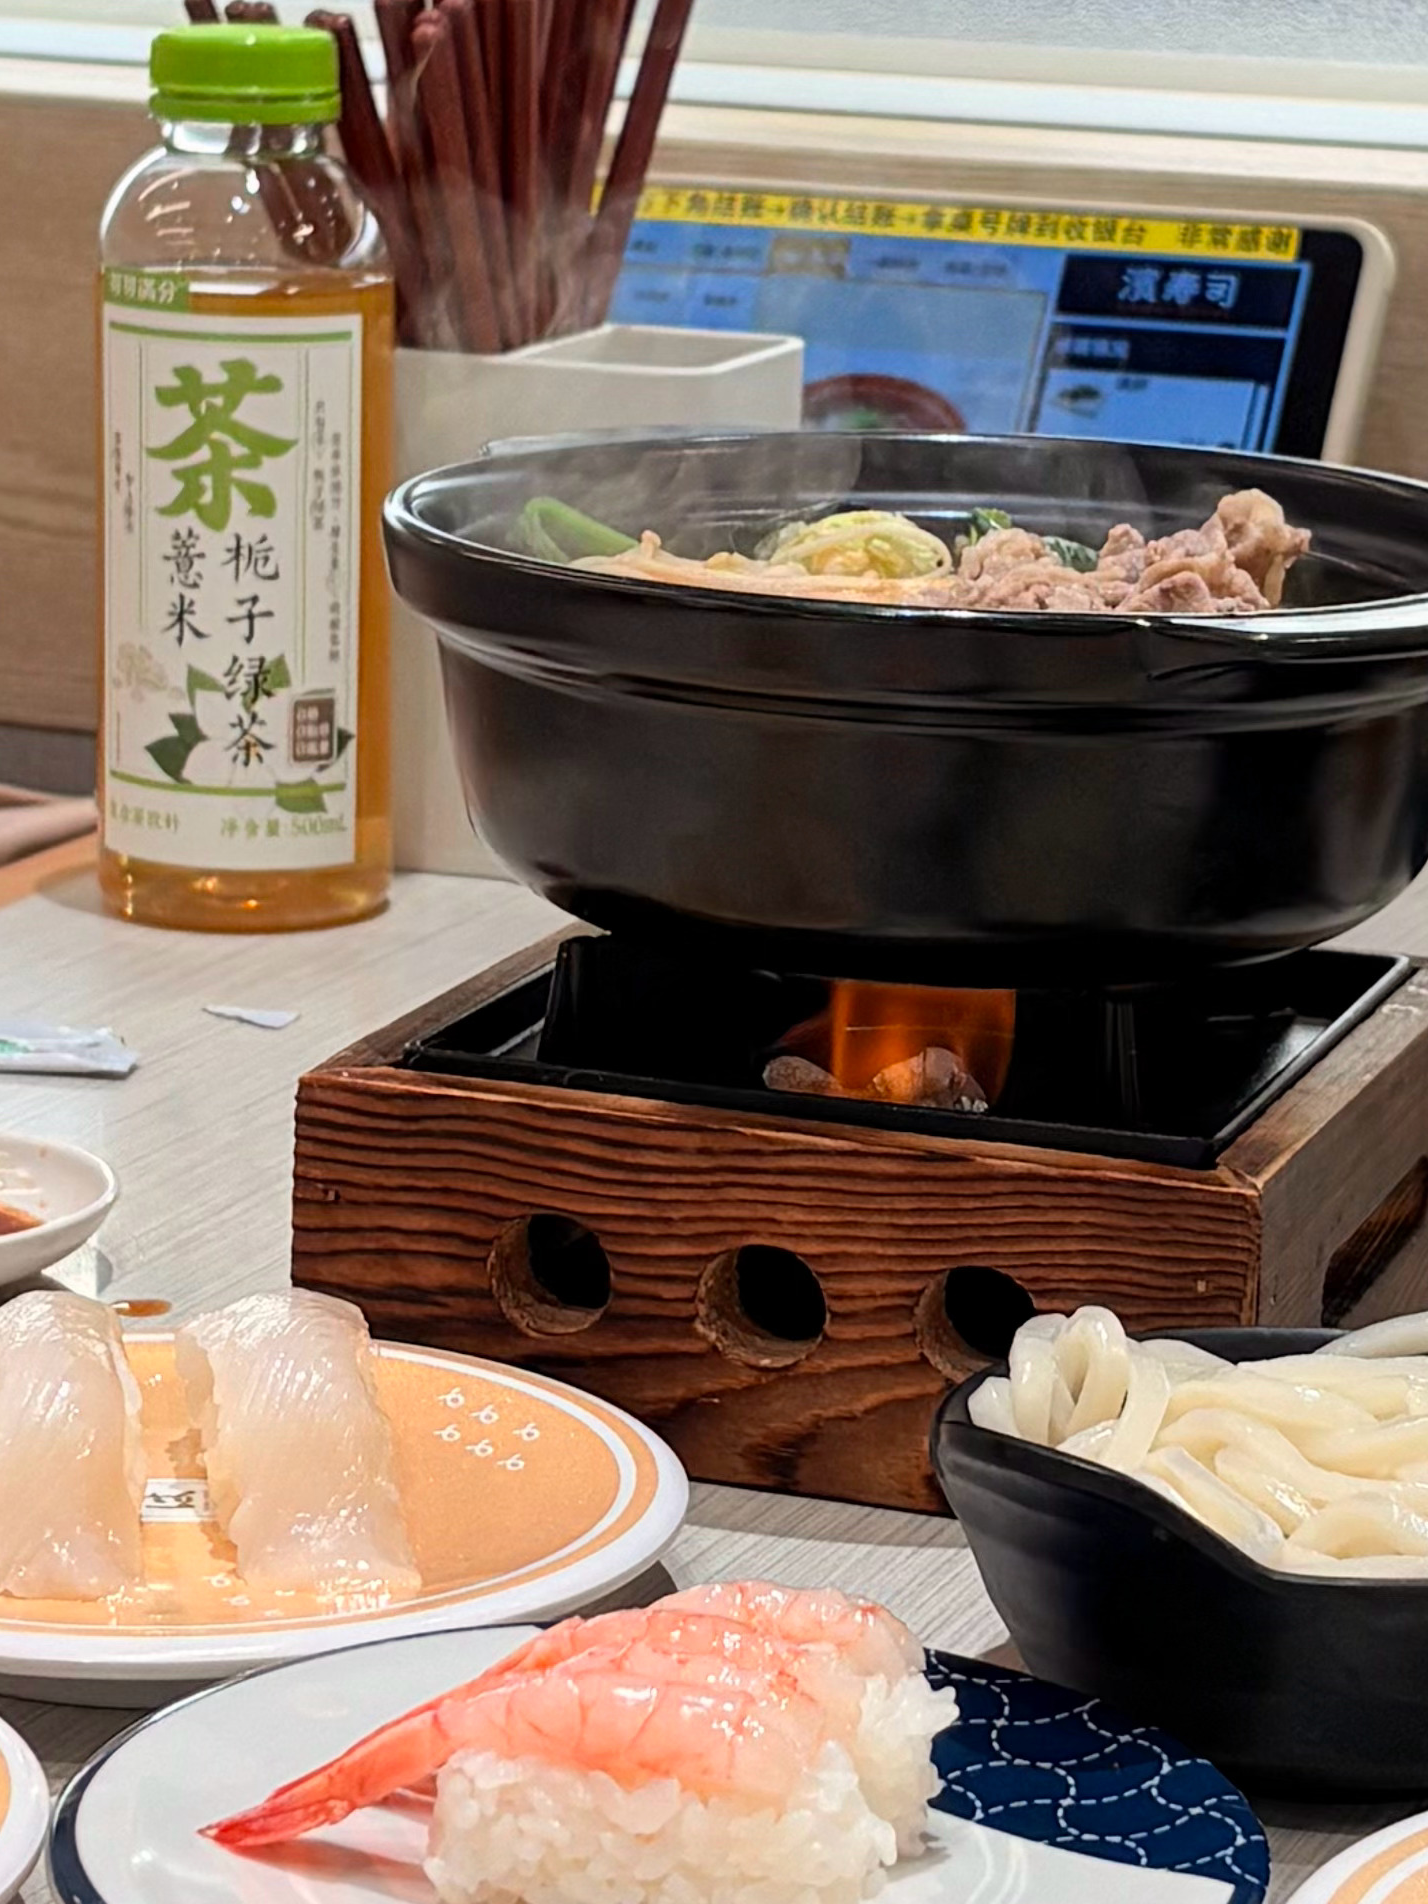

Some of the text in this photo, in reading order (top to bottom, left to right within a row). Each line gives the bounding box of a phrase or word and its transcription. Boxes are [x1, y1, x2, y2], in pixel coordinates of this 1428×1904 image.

[146, 359, 299, 531] 茶
[160, 528, 209, 649] 薏米
[220, 531, 281, 768] 栀子绿茶
